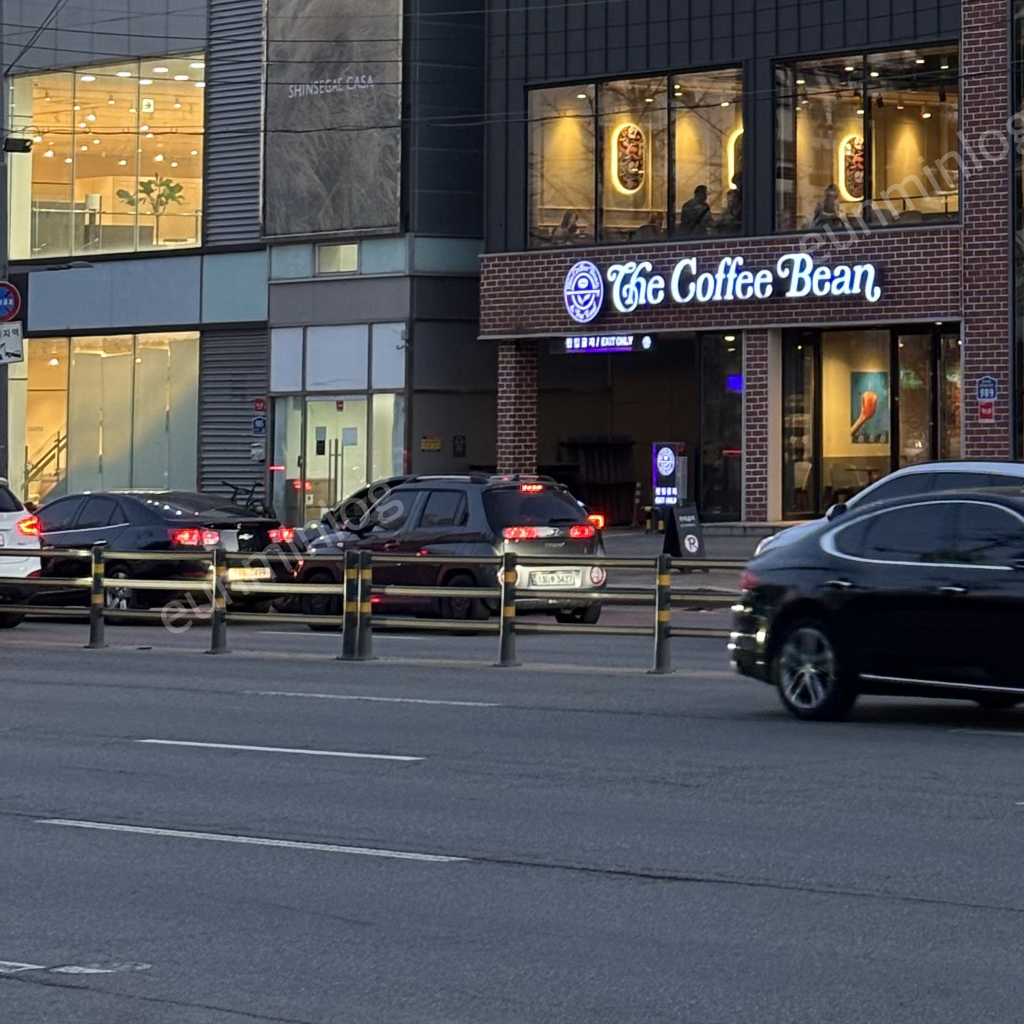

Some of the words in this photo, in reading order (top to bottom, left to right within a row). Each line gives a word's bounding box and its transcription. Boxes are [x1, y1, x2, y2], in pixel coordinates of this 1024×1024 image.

[289, 78, 343, 98] SHINSEGAE
[346, 75, 374, 90] CASA
[606, 261, 665, 313] The
[670, 256, 773, 303] Coffee
[776, 253, 881, 303] Bean
